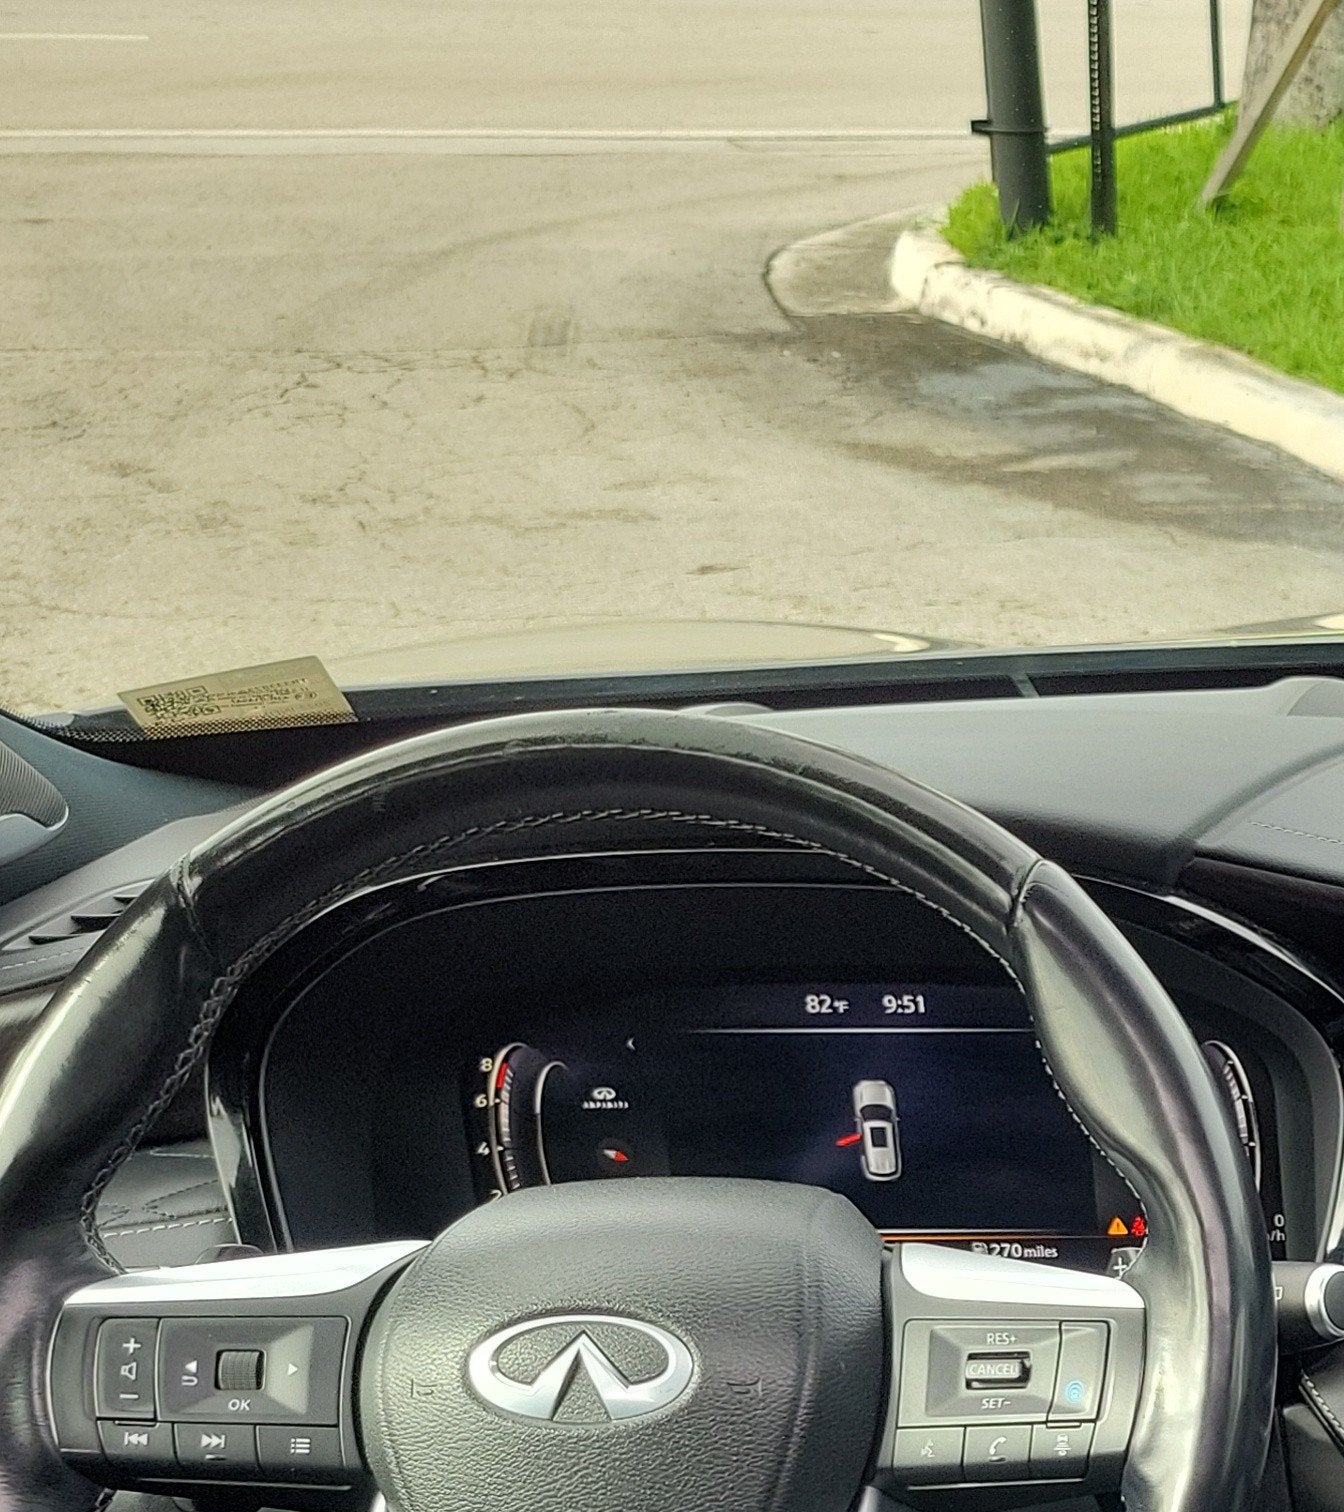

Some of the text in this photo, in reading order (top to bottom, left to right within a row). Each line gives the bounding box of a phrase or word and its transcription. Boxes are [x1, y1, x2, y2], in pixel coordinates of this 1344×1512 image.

[882, 994, 926, 1014] 9:51
[480, 1057, 493, 1072] 8
[474, 1094, 488, 1108] 6
[477, 1142, 491, 1156] 4
[1273, 1214, 1285, 1227] 0
[986, 1332, 1018, 1345] RES+
[969, 1363, 1019, 1376] CANCEL
[227, 1399, 251, 1412] OK
